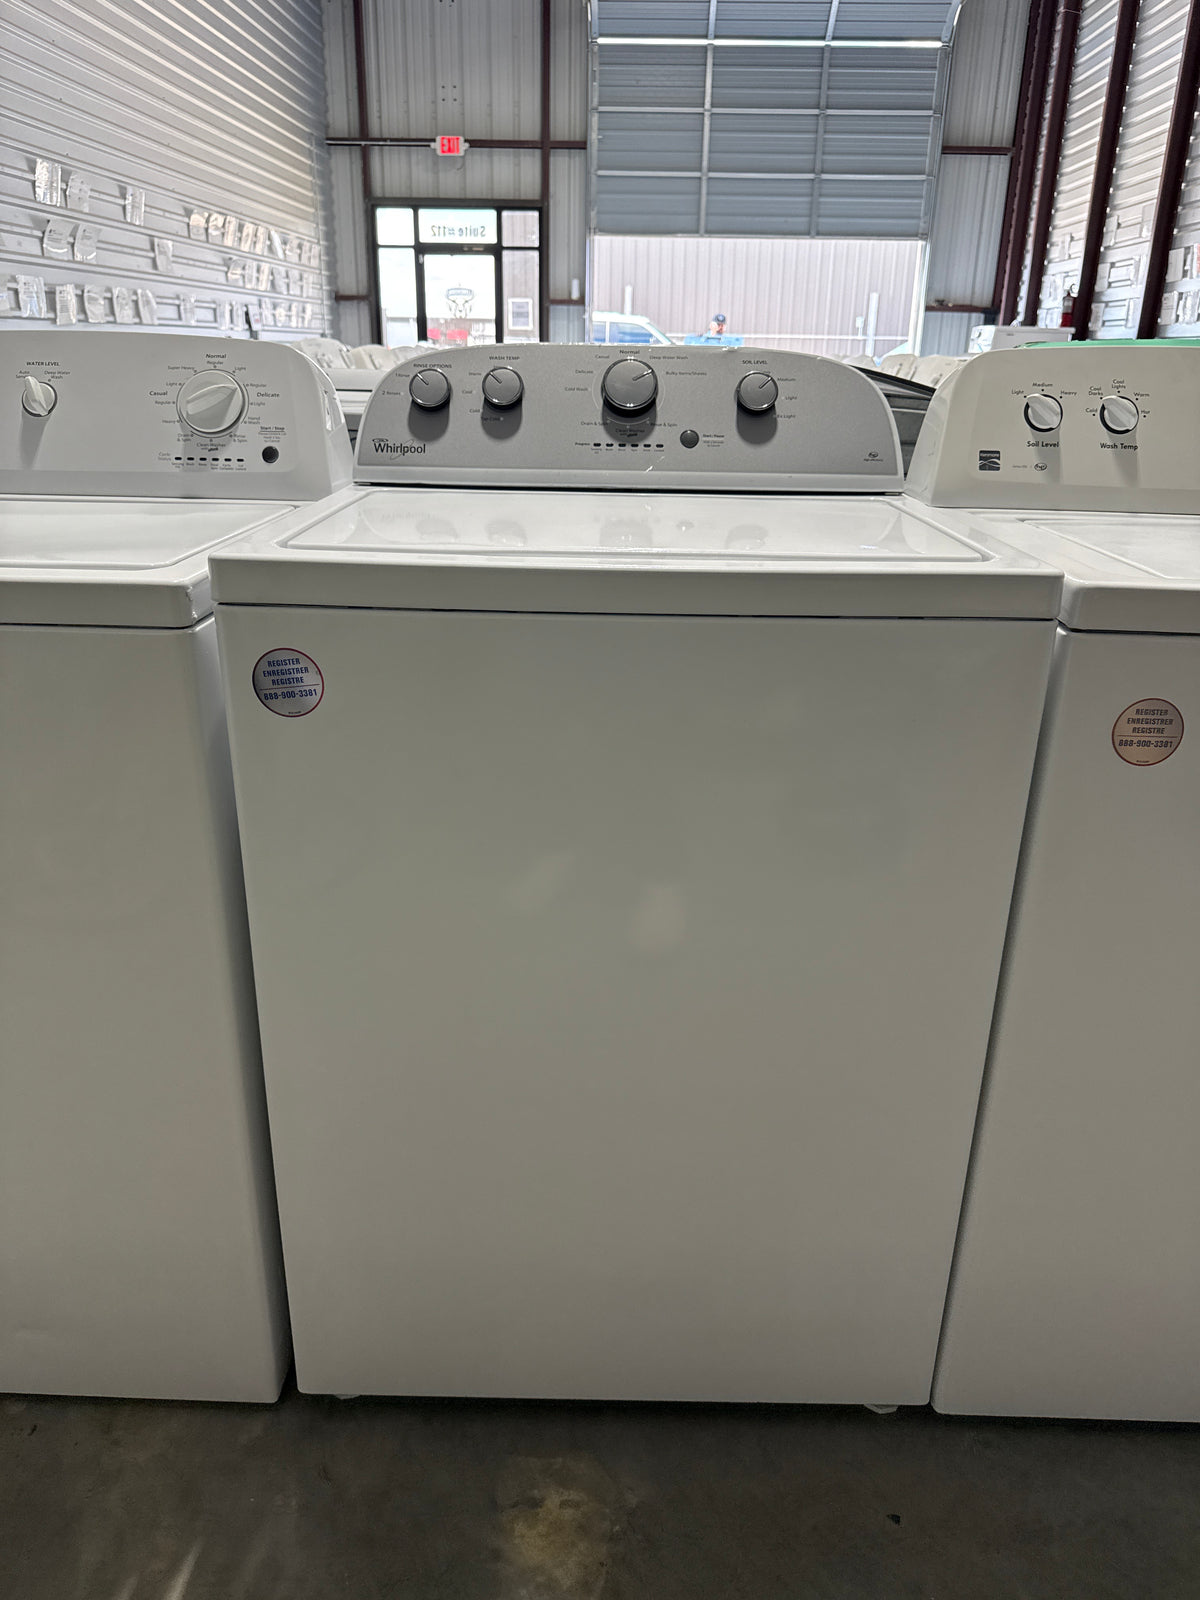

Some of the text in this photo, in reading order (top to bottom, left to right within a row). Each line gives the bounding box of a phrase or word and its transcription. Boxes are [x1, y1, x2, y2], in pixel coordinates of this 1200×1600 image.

[440, 136, 460, 154] EXIT
[373, 442, 427, 456] Whirlpool
[1120, 443, 1139, 451] Temp
[267, 658, 301, 667] REGISTER
[263, 667, 309, 677] ENREGISTRER
[272, 677, 304, 686] REGISTRE
[263, 688, 317, 700] 888-900-3381
[1135, 708, 1169, 716] REGISTER
[1127, 717, 1174, 725] ENREGISTRER
[1132, 726, 1166, 734] REGISTRE
[1118, 739, 1173, 748] 888-900-3381
